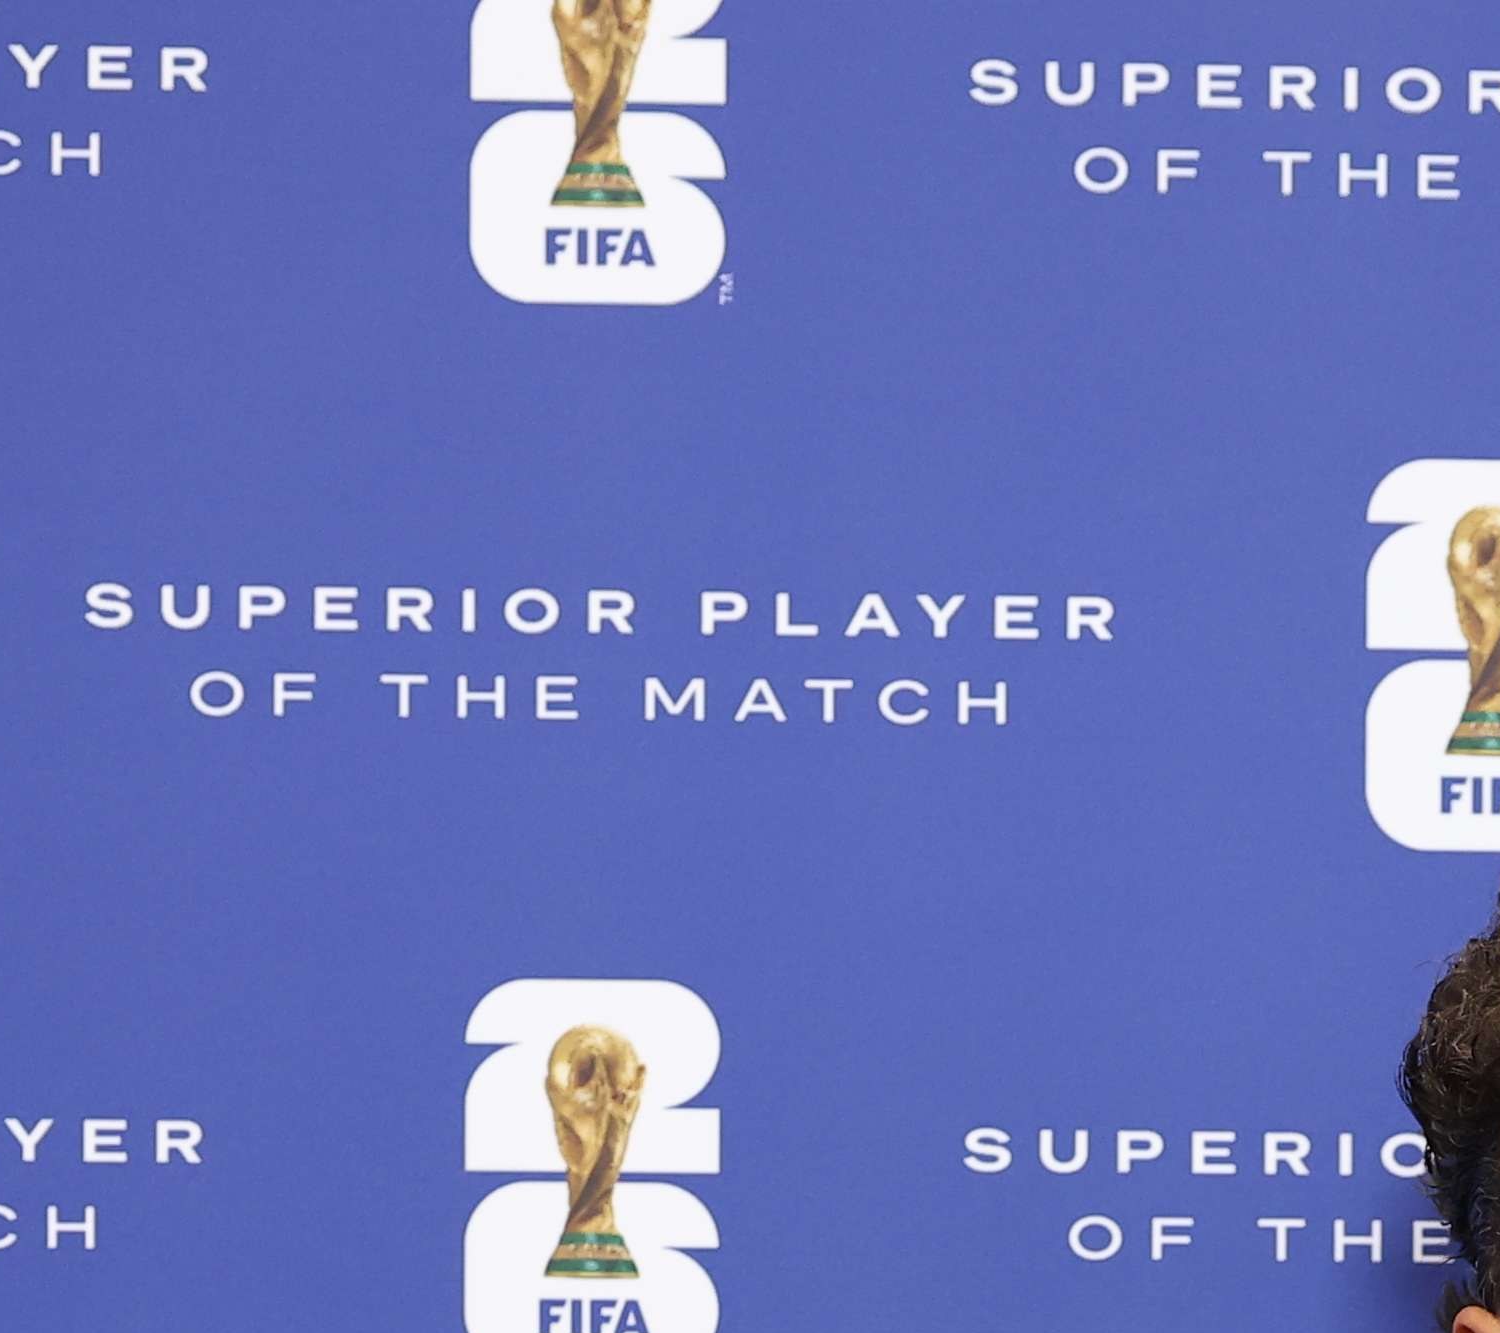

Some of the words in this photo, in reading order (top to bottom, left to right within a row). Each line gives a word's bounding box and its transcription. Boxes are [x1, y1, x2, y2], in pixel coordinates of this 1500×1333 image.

[1073, 146, 1201, 194] OF
[1261, 150, 1462, 200] THE
[545, 227, 655, 267] FIFA
[84, 582, 636, 635] SUPERIOR
[700, 590, 1115, 642] PLAYER
[189, 670, 317, 718] OF
[378, 673, 580, 721] THE
[643, 676, 1008, 726] MATCH
[962, 1126, 1428, 1179] SUPERIO
[1067, 1214, 1195, 1262] OF
[1256, 1217, 1452, 1264] THE
